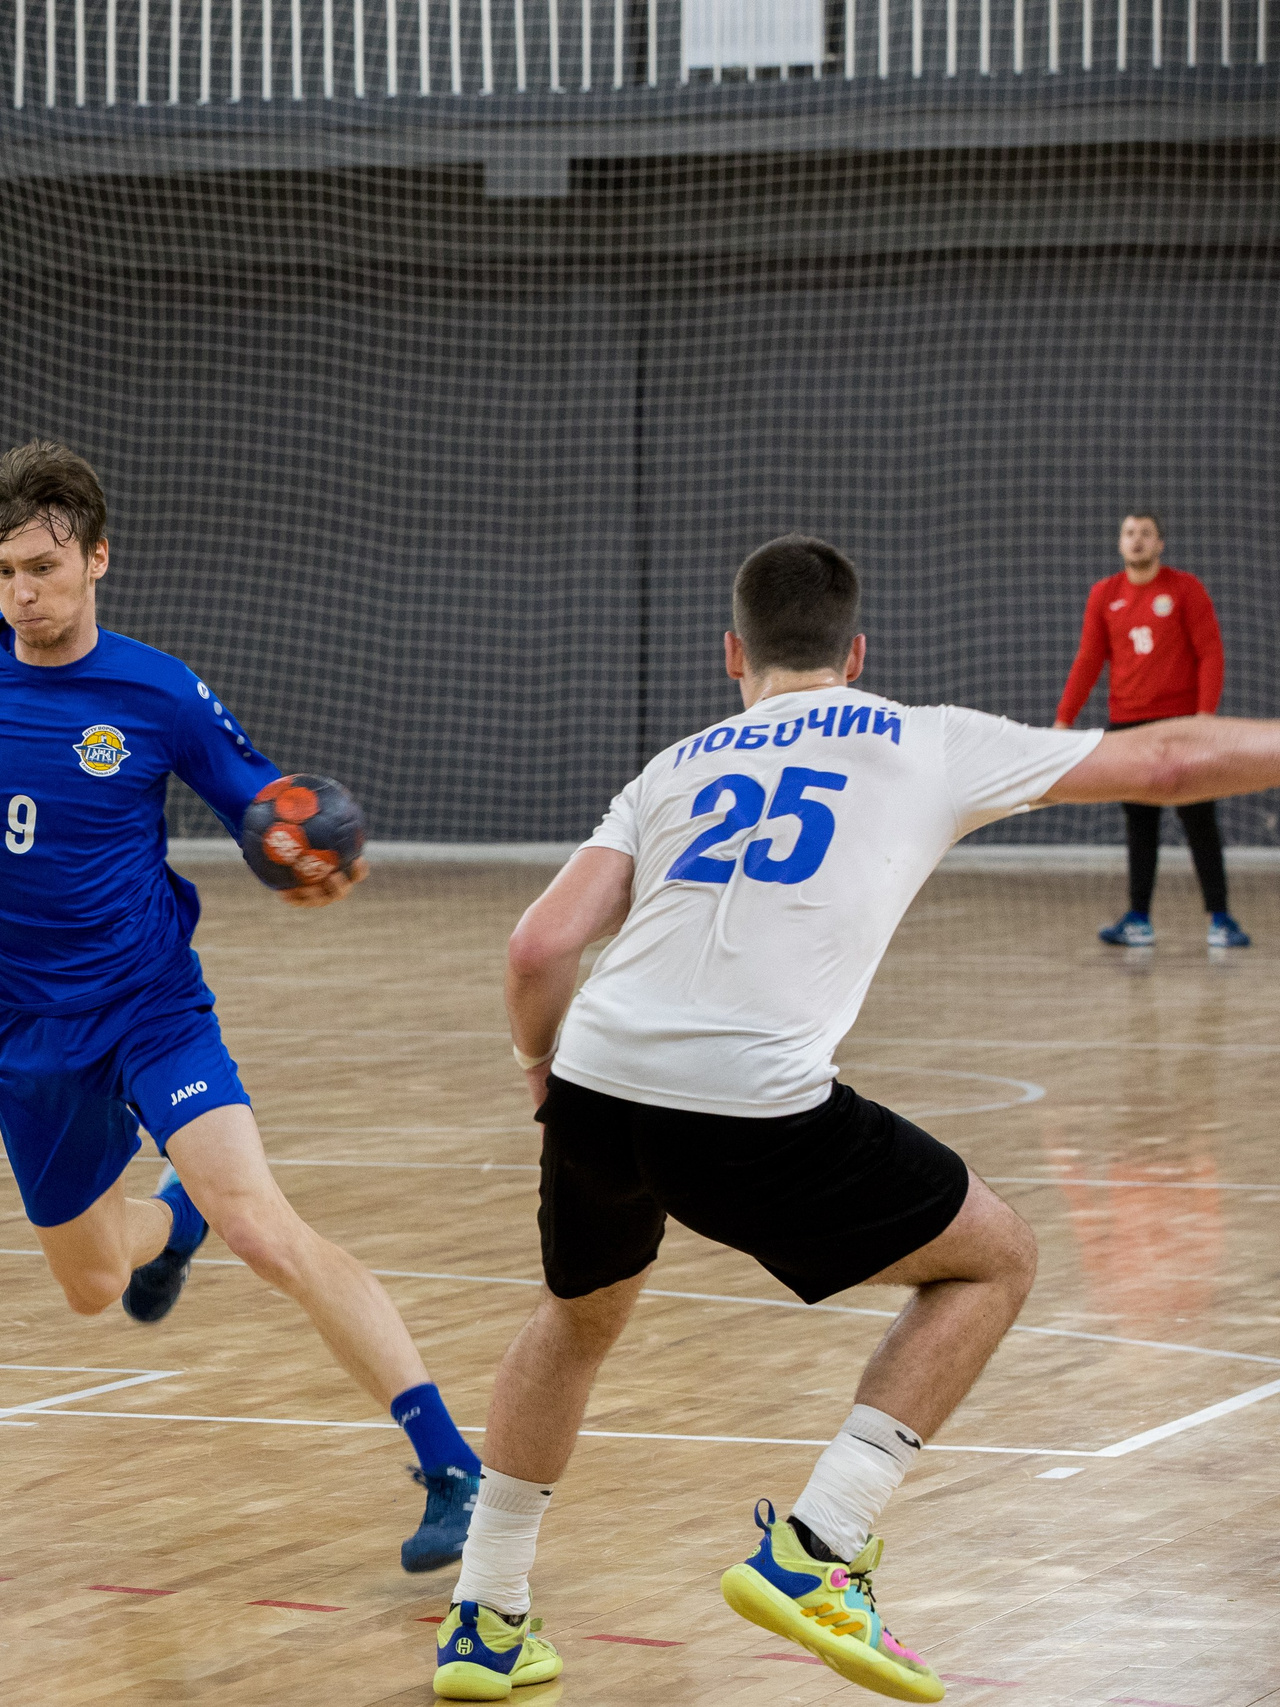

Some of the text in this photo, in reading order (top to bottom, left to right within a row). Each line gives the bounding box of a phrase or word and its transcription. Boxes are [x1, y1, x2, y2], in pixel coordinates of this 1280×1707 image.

[673, 704, 902, 769] ПОБОЧИЙ
[5, 794, 38, 855] 9
[664, 766, 849, 885] 25
[170, 1080, 208, 1106] JAKO
